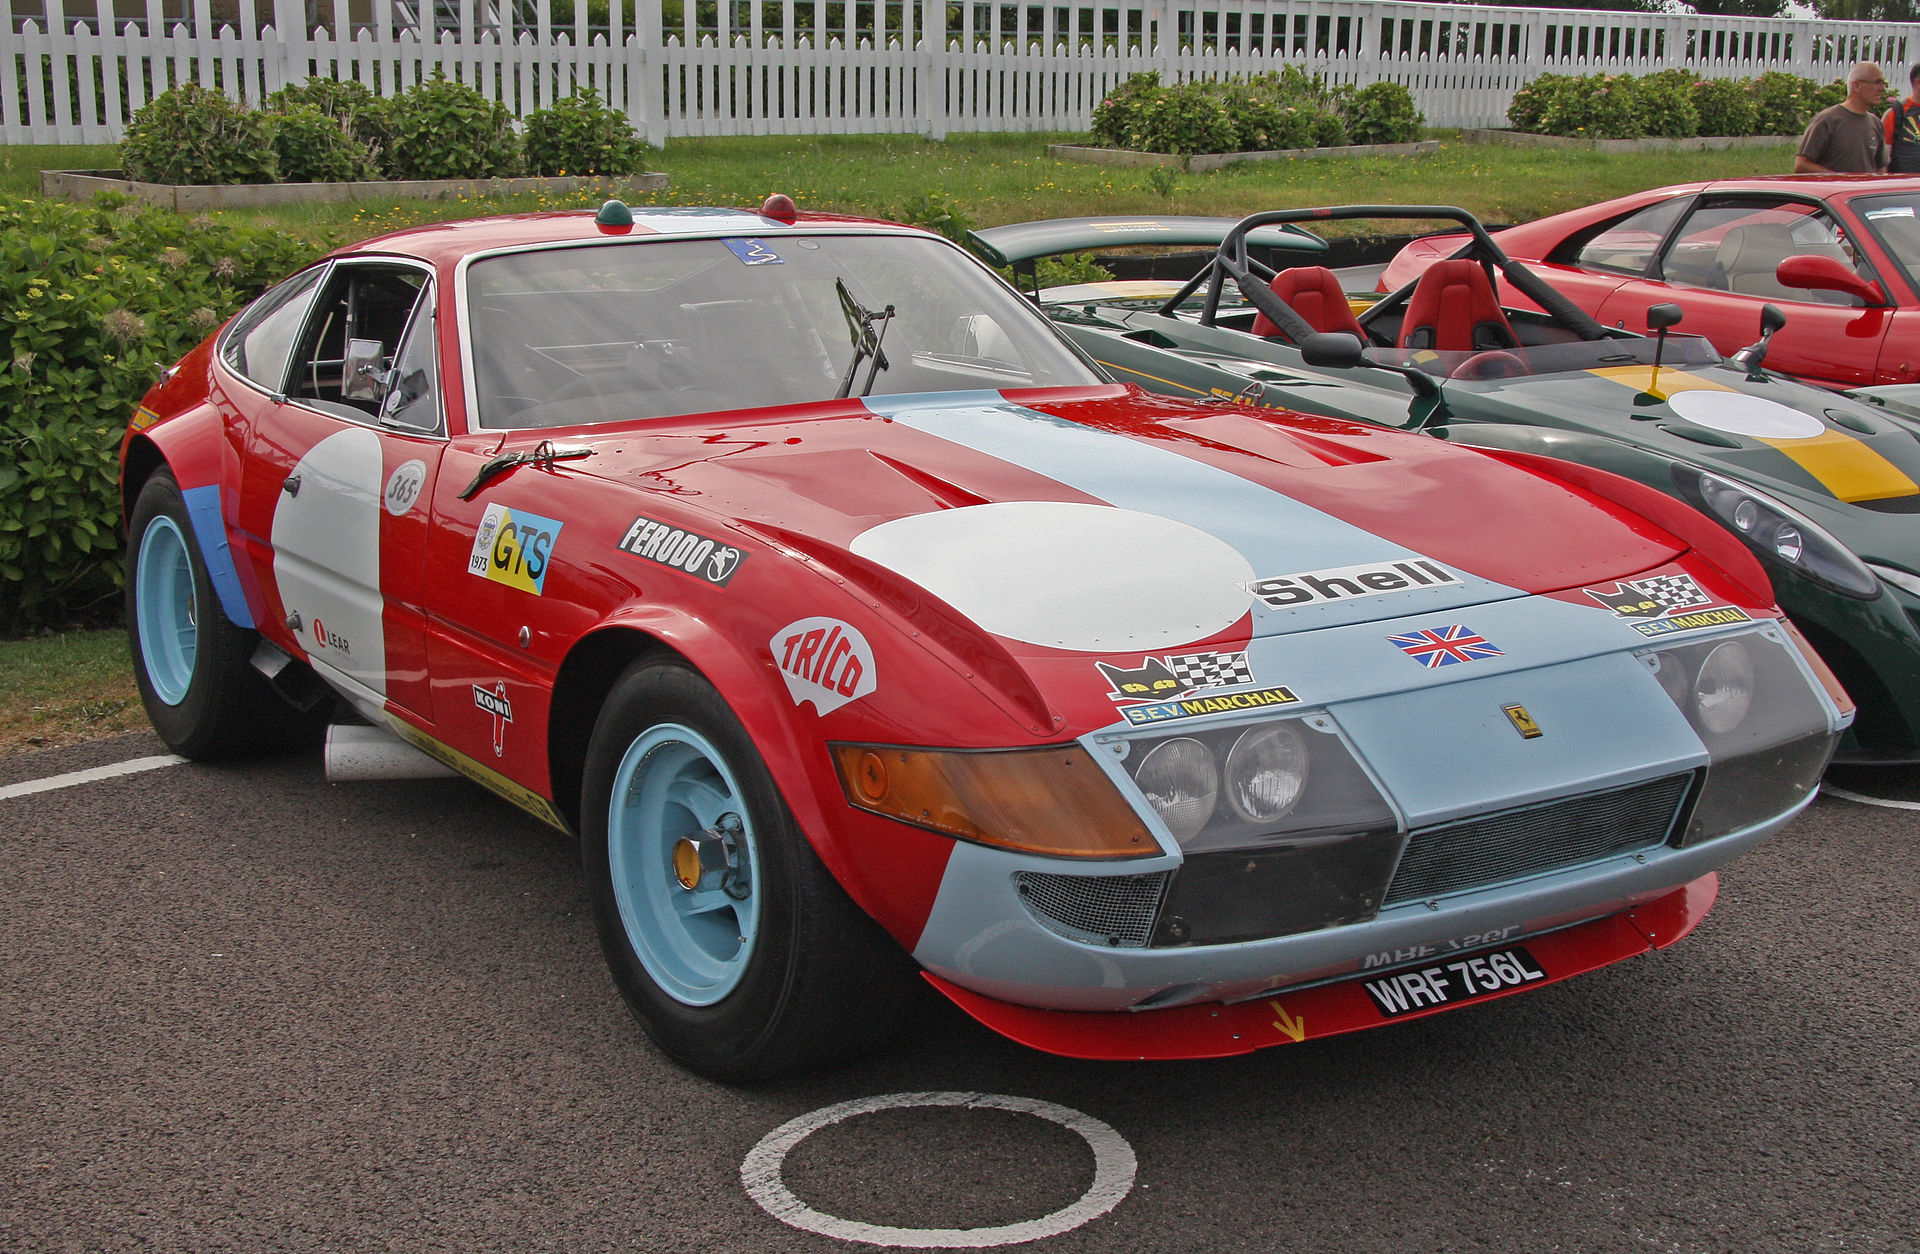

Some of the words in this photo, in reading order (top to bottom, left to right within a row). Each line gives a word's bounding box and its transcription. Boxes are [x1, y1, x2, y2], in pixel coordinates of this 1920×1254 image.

[388, 475, 417, 503] 365
[494, 522, 551, 580] GTS
[620, 517, 714, 573] FERODO
[470, 554, 488, 571] 1973
[1251, 560, 1455, 605] Shell
[1636, 620, 1676, 635] S.E.V.
[1670, 609, 1748, 629] MARCHAL
[326, 630, 350, 655] LEAR
[781, 625, 863, 698] TRICO
[475, 690, 510, 717] KONI
[1127, 704, 1184, 722] S.E.V.
[1180, 690, 1295, 715] MARCHAL
[1365, 967, 1450, 1013] WRF
[1447, 951, 1544, 994] 756L
